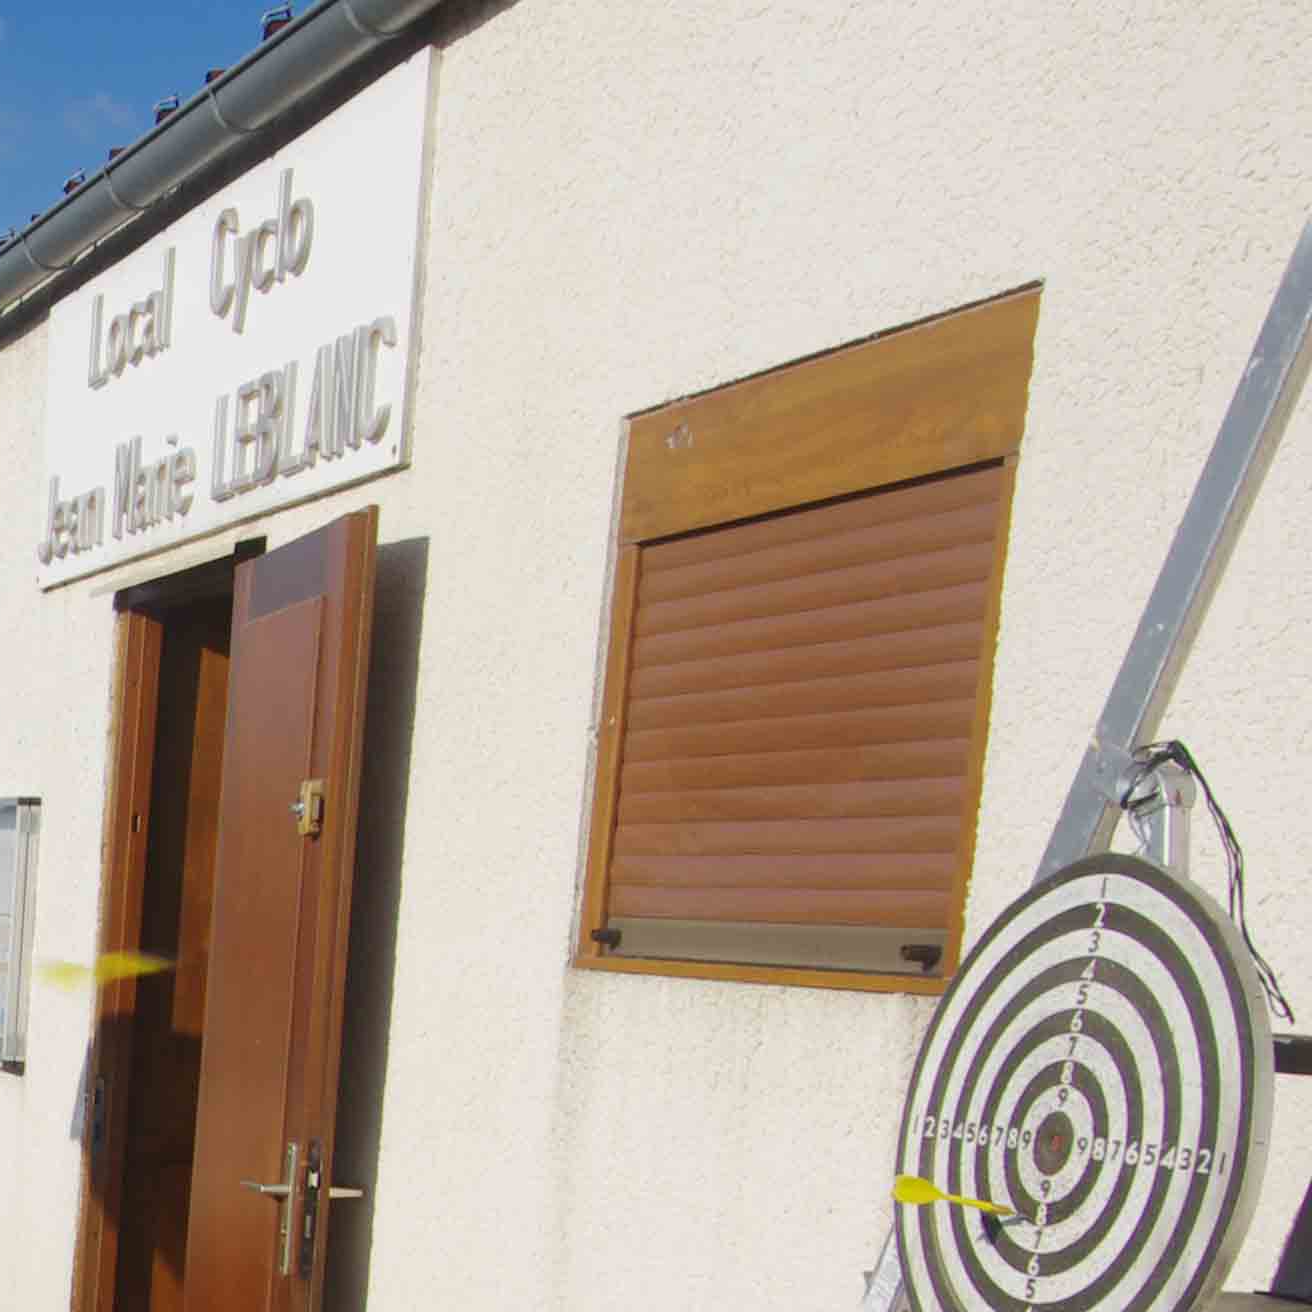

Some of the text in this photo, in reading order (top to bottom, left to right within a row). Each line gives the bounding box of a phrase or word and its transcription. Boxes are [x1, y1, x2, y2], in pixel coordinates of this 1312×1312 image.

[88, 167, 314, 390] Local Cyclo
[38, 315, 397, 566] Jean Marie LEBLANC
[1077, 1136, 1089, 1155] 9
[1092, 1138, 1106, 1160] 8
[1110, 1140, 1121, 1161] 7
[1125, 1141, 1140, 1165] 6
[1142, 1144, 1156, 1165] 5
[1159, 1146, 1177, 1170] 4
[1179, 1148, 1193, 1170] 3
[1196, 1150, 1211, 1174] 2
[1218, 1152, 1226, 1175] 1
